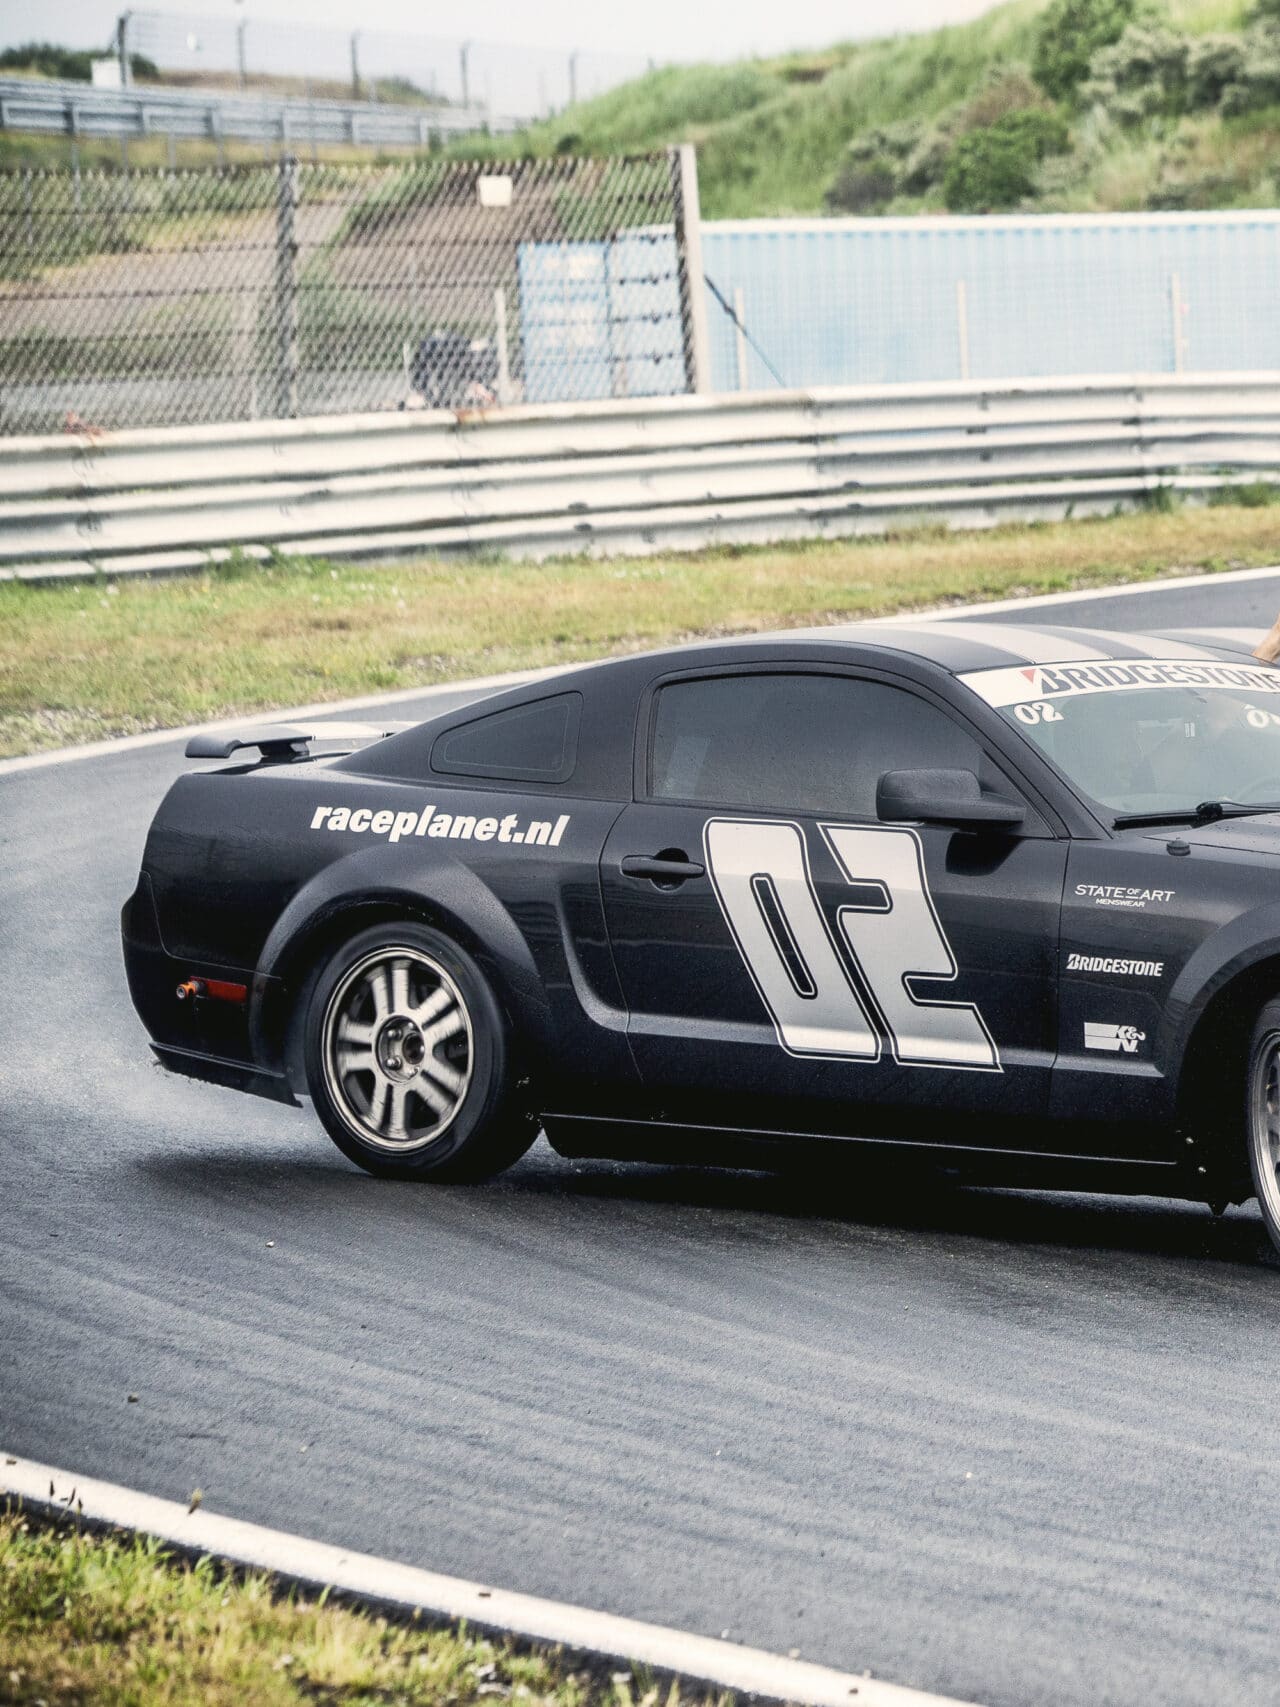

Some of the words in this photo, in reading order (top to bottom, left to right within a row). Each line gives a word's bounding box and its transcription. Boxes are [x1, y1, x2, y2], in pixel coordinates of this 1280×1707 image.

[1013, 701, 1065, 725] 02
[310, 805, 571, 846] raceplanet.nl
[1075, 884, 1126, 898] STATE
[1126, 888, 1141, 896] OF
[1140, 889, 1175, 902] ART
[1095, 898, 1145, 908] MENSWEAR
[703, 816, 1004, 1073] 02
[1066, 953, 1164, 977] BRIDGESTONE
